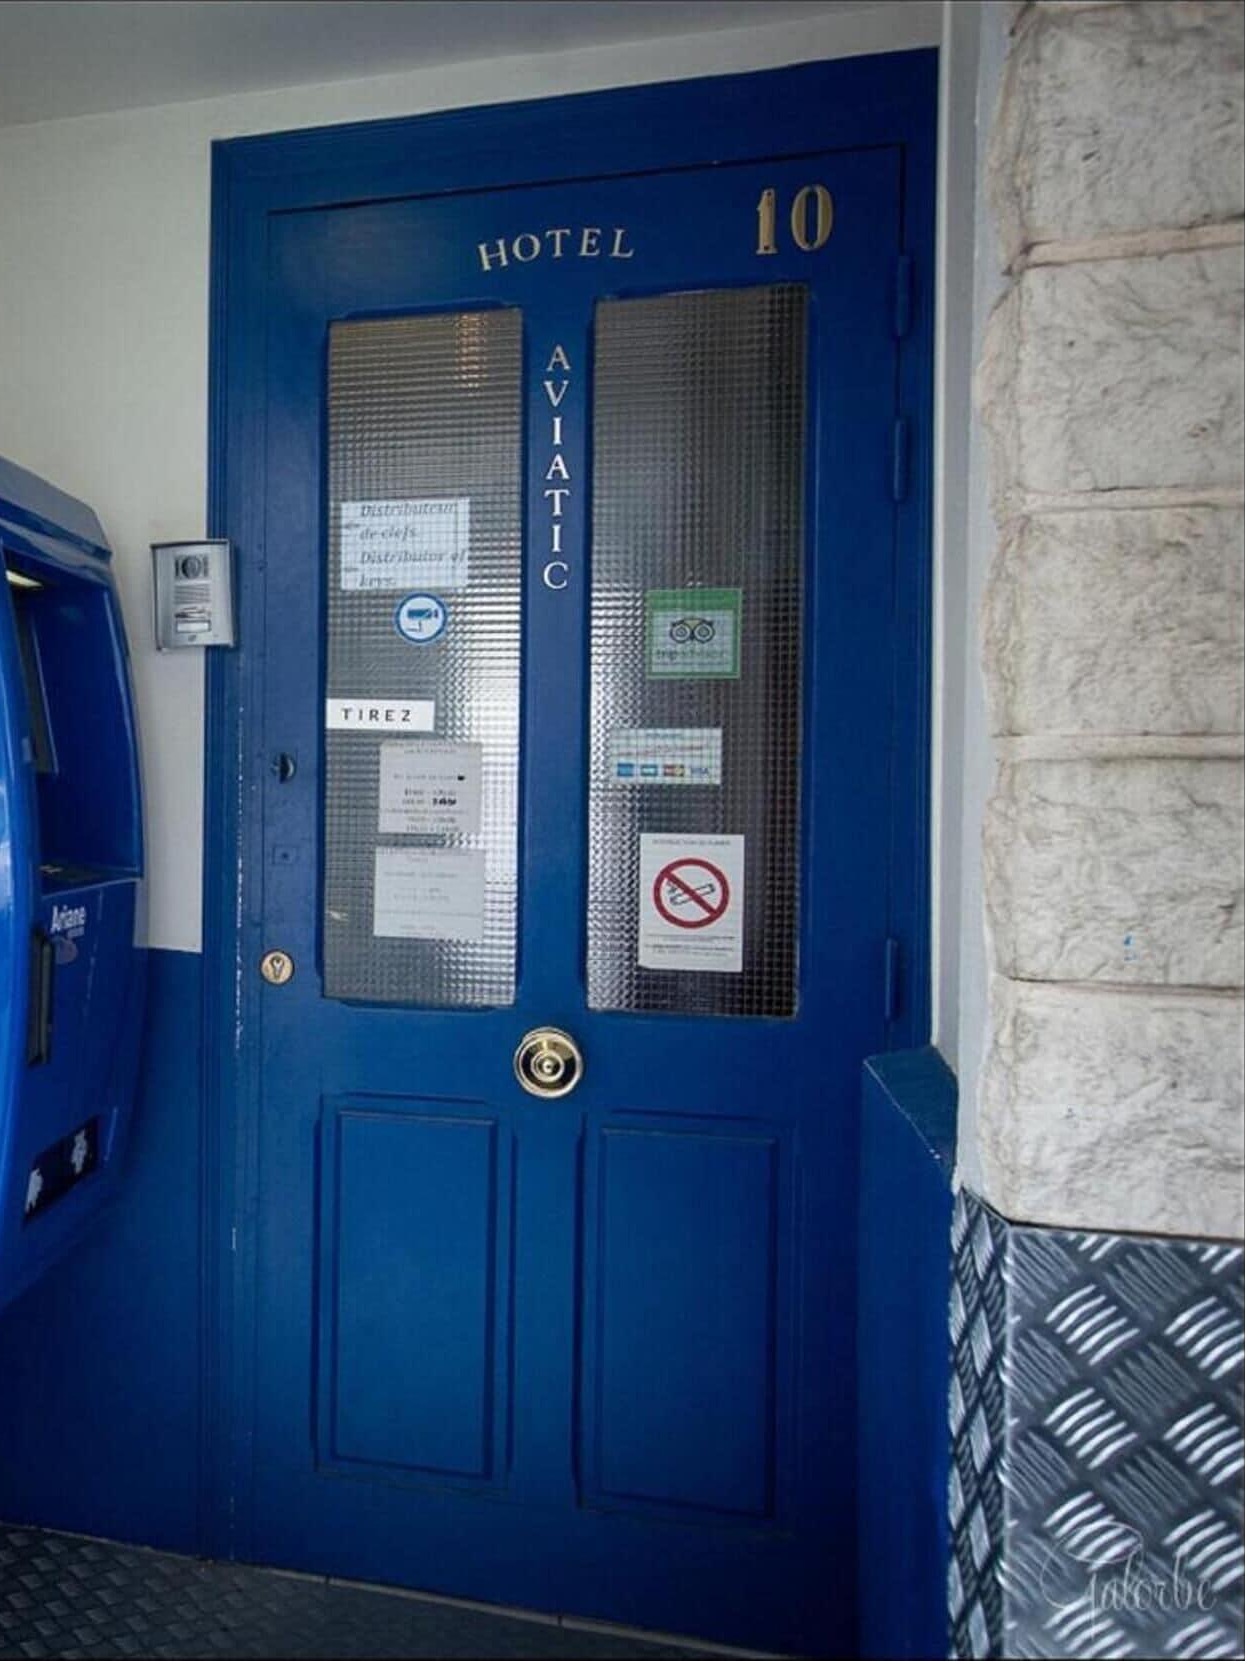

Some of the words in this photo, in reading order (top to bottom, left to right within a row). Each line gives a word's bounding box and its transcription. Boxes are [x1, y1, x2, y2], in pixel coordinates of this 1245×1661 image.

[756, 184, 833, 256] 10
[477, 227, 635, 272] HOTEL
[542, 344, 571, 590] AVIATIC
[341, 708, 412, 722] TIREZ
[50, 904, 86, 934] Ariane
